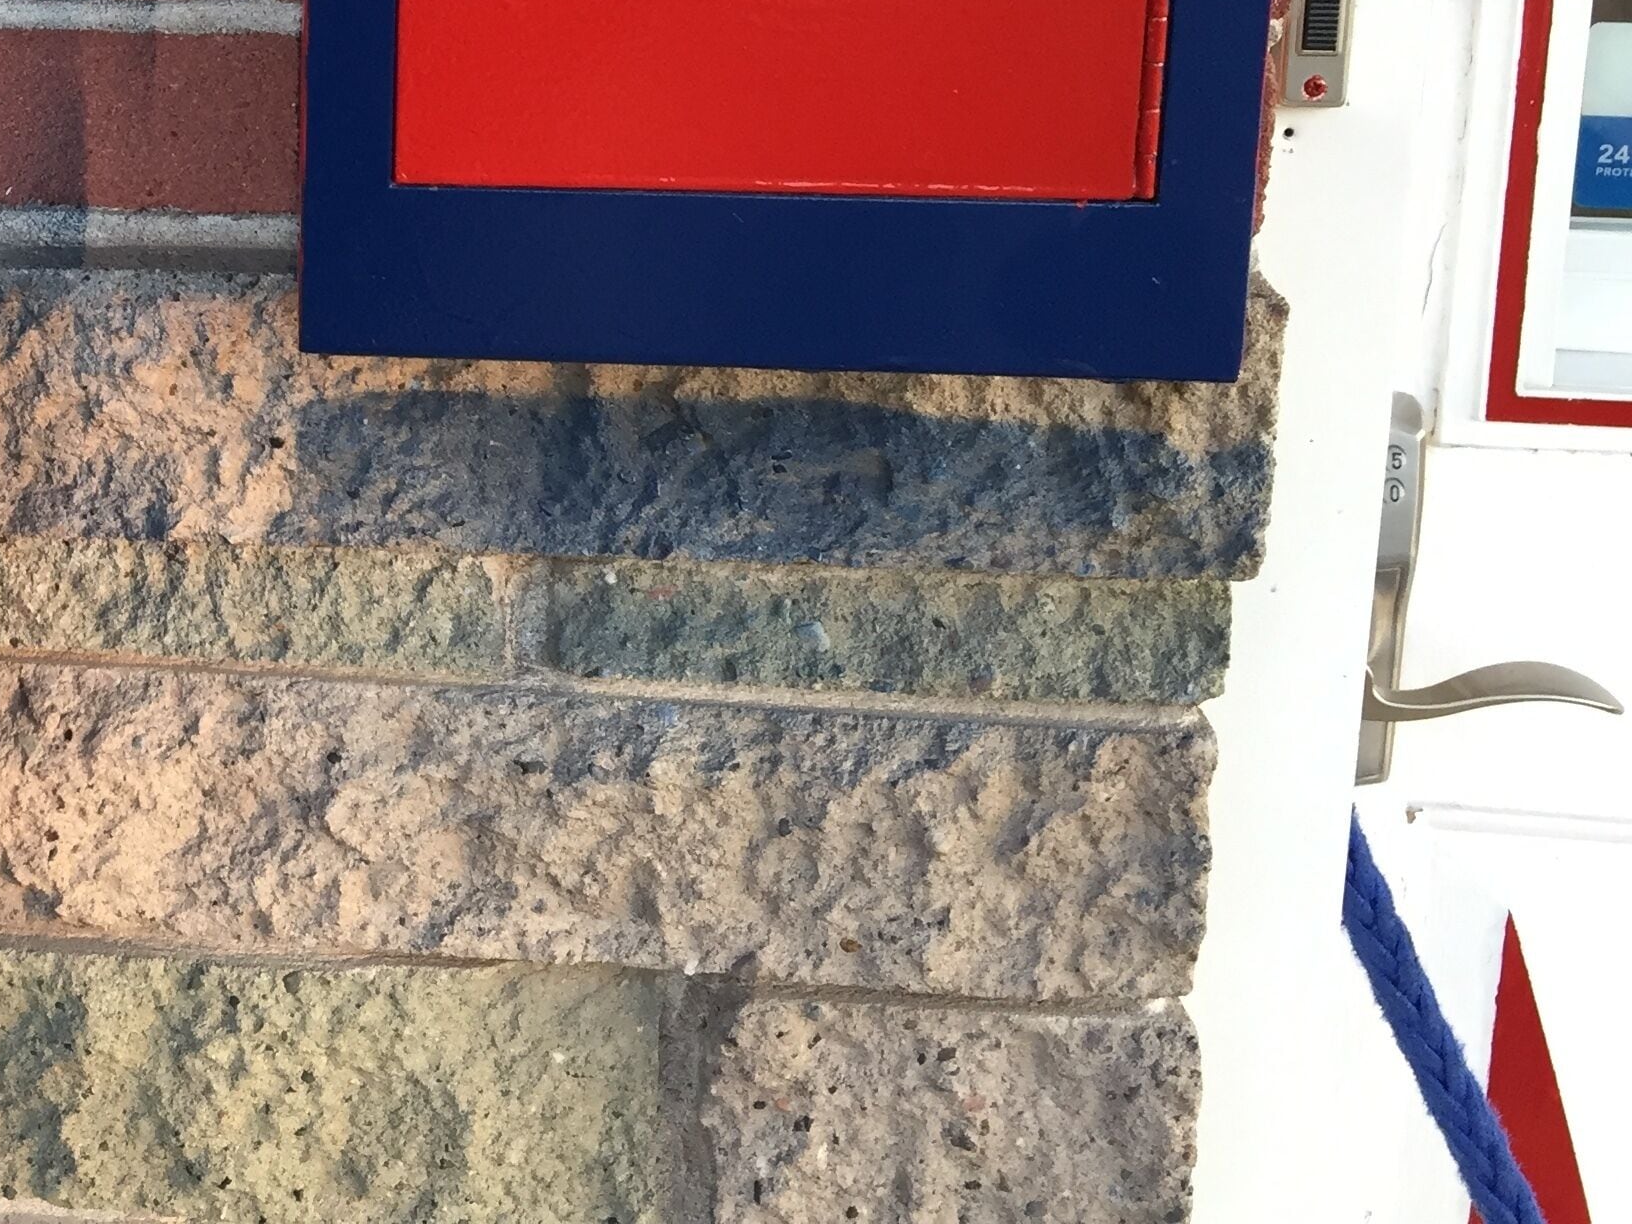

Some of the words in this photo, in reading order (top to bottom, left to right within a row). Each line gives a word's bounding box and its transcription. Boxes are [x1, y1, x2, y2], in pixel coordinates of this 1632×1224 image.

[1597, 143, 1630, 164] 24
[1391, 451, 1403, 470] 5
[1389, 484, 1400, 503] 0
